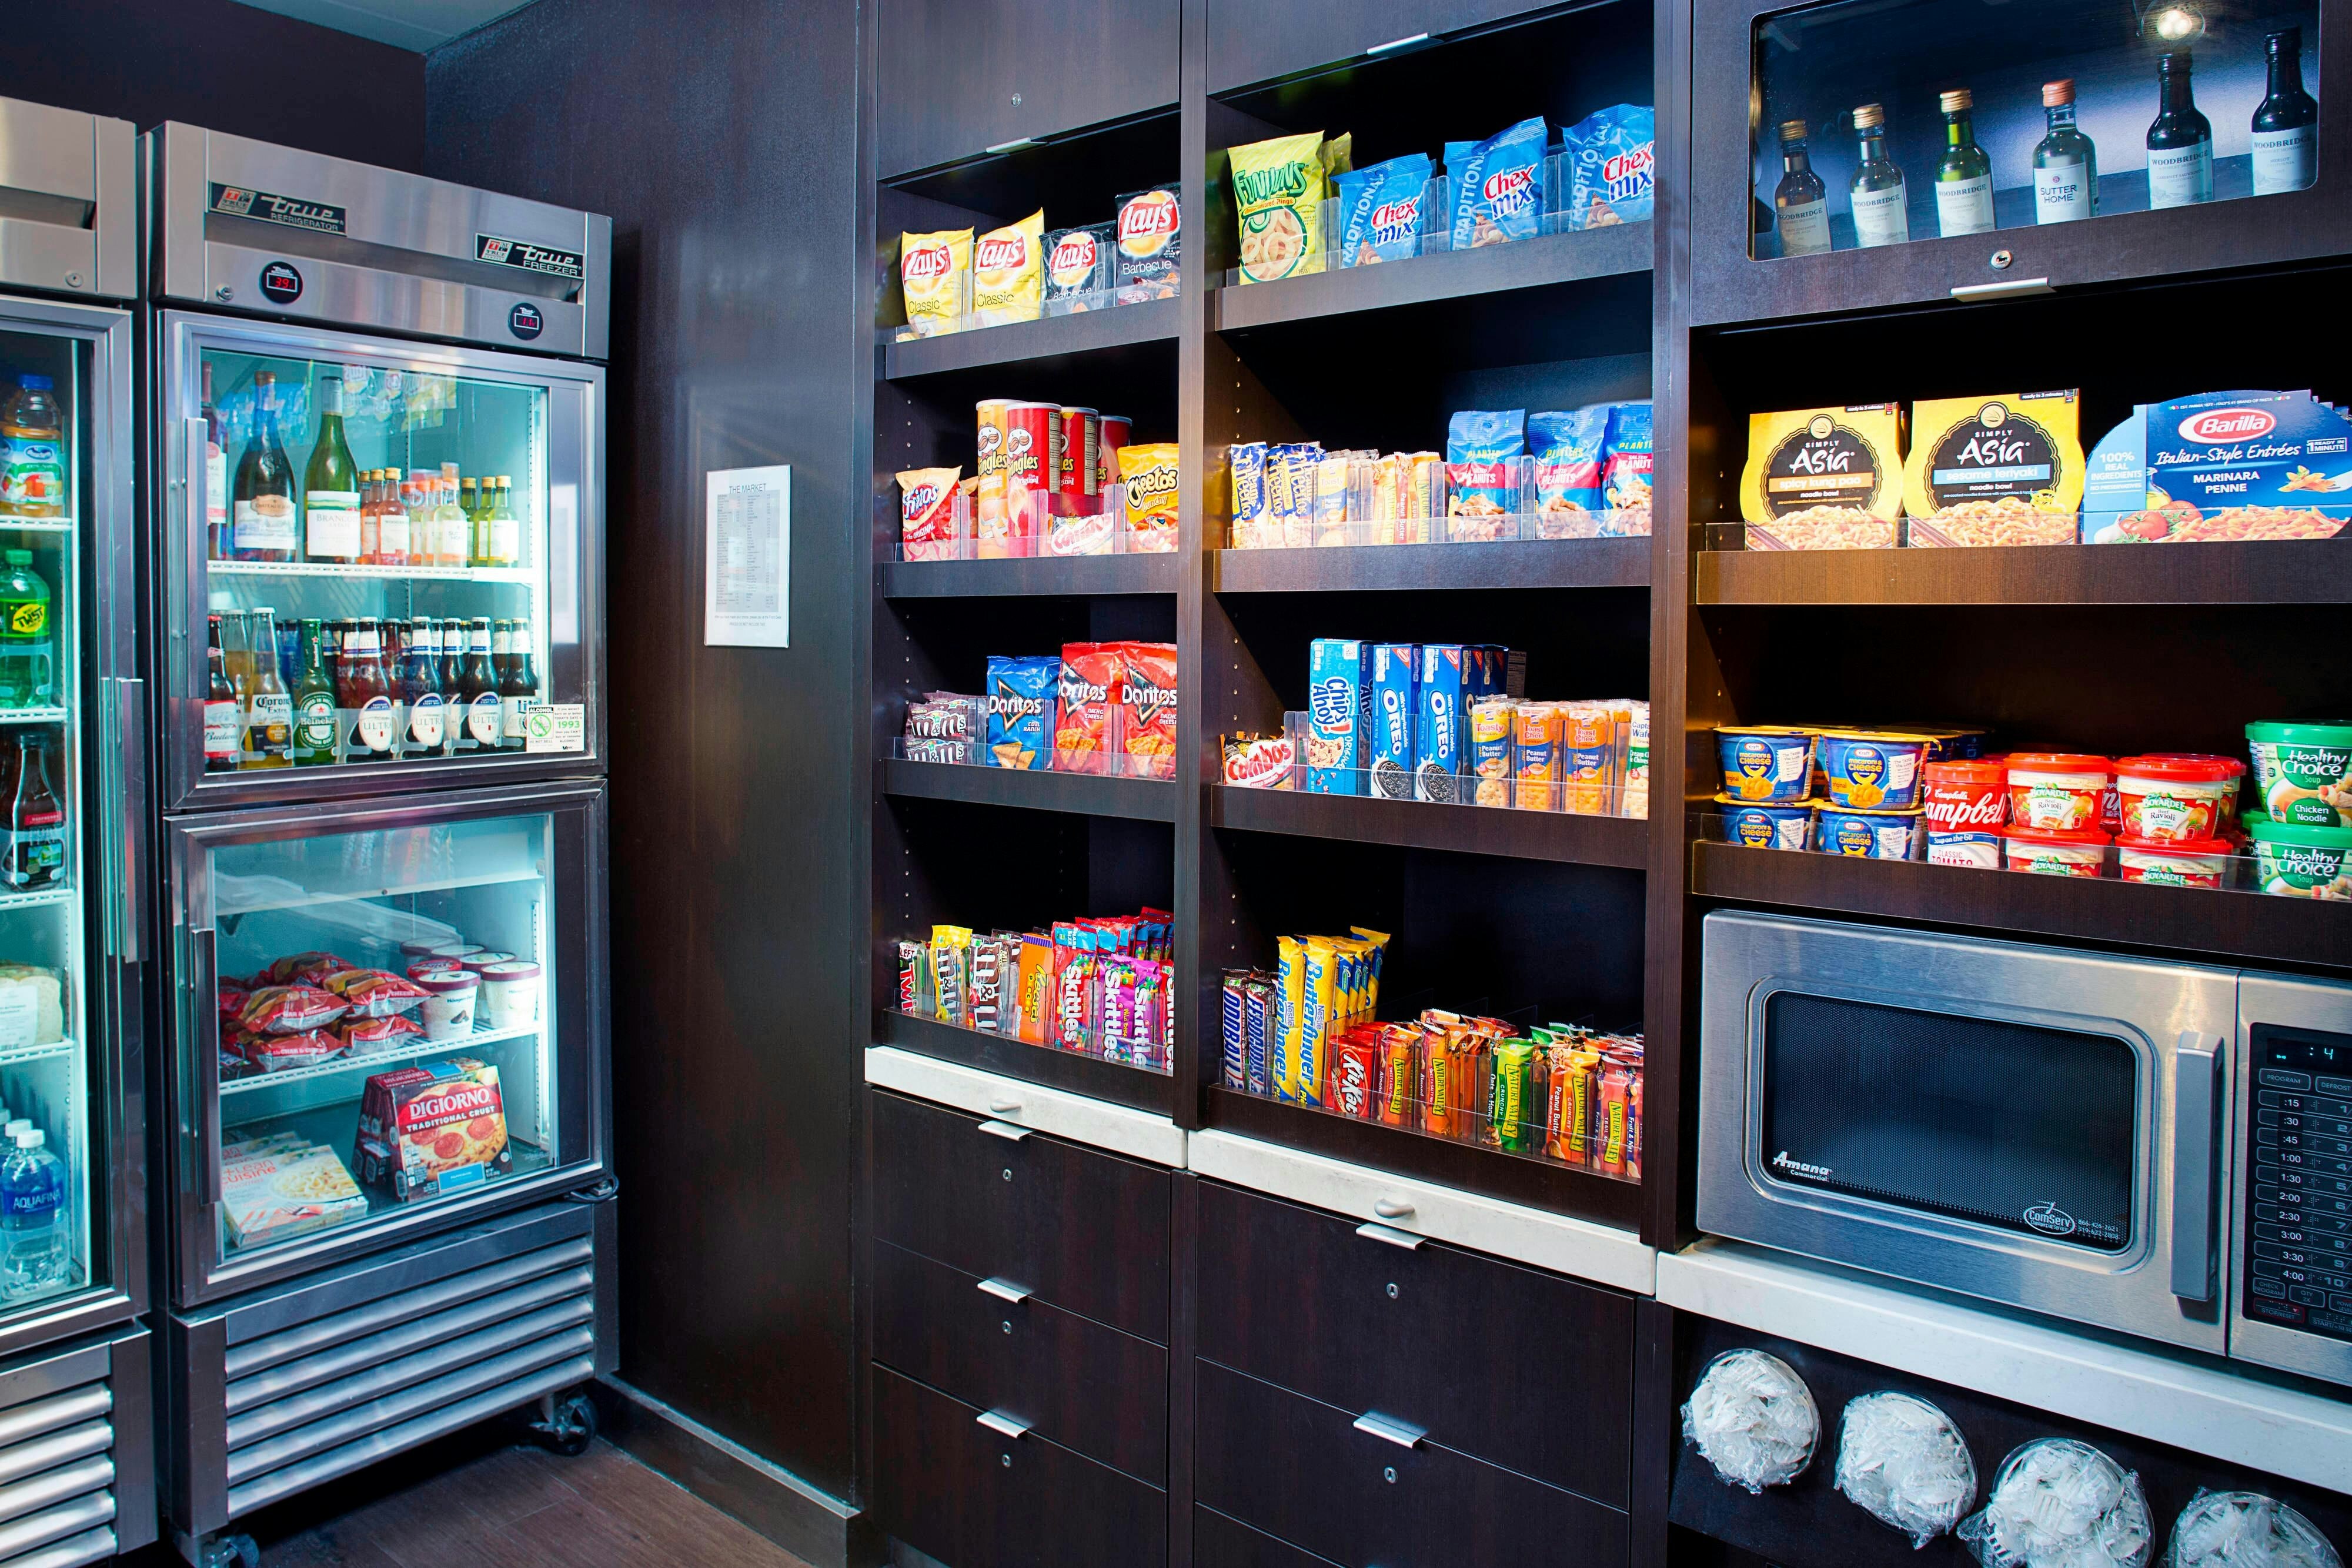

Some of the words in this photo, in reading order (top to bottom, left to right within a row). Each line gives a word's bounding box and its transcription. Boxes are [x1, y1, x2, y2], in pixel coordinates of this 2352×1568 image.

[1603, 142, 1653, 180] Chex
[2152, 150, 2209, 166] WOODBRIDGE
[1234, 161, 1307, 206] FUNYUNS
[1485, 166, 1533, 199] Chex
[1938, 184, 1986, 197] WOODBRIDGE
[2040, 185, 2077, 195] SUTTER
[1853, 194, 1900, 207] WOODBRIDGE
[2044, 193, 2073, 203] HOME
[1372, 198, 1418, 227] Chex
[1779, 207, 1823, 220] WOODBRIDGE
[270, 212, 339, 231] REFRIGERATOR
[1120, 201, 1176, 239] Lay's
[976, 236, 1024, 272] Lay's
[1051, 239, 1094, 276] Lay's
[523, 259, 578, 276] FREEZER
[906, 243, 947, 279] Lay's
[1053, 286, 1092, 302] Barbecue
[908, 297, 940, 313] Classic
[1975, 429, 2013, 438] SIMPLY
[2200, 414, 2267, 440] Barilla
[2308, 441, 2314, 453] 1
[1789, 447, 1850, 474] Asia
[2099, 452, 2135, 463] 100%
[2154, 446, 2244, 466] Italian-Style
[2247, 442, 2301, 459] Entrées
[1541, 472, 1576, 485] PEANUTS
[1946, 470, 1992, 482] sesame
[1994, 467, 2037, 480] teriyaki
[2090, 470, 2143, 481] INGREDIENTS
[2192, 471, 2260, 484] MARINARA
[729, 485, 741, 494] THE
[741, 483, 767, 493] MARKET
[1126, 465, 1178, 508] Cheetos
[1233, 458, 1252, 519] Cheerios
[1779, 479, 1807, 490] spicy
[1809, 477, 1836, 488] kung
[1839, 476, 1861, 487] pao
[2100, 482, 2142, 490] PRESERVATIVES
[2205, 484, 2247, 494] PENNE
[1142, 496, 1168, 512] Crunchy
[913, 521, 936, 539] ORIGINAL
[989, 696, 1041, 714] Doritos
[1326, 678, 1348, 725] Chips
[558, 720, 580, 728] 1993
[1382, 688, 1402, 756] OREO
[1476, 723, 1504, 733] Toasty
[1524, 724, 1544, 733] Toast
[1524, 731, 1545, 740] Chee
[1575, 727, 1596, 736] Toast
[2287, 749, 2347, 765] Healthy
[2281, 760, 2343, 776] Choice
[2305, 776, 2321, 784] Soup
[2030, 788, 2071, 801] BOYARDEE
[2037, 802, 2062, 810] Ravioli
[2294, 804, 2330, 814] Chicken
[2150, 812, 2176, 821] Ravioli
[2297, 814, 2327, 823] Noodle
[1938, 850, 1963, 859] CLASSIC
[900, 949, 915, 958] LEFT
[1064, 965, 1083, 1042] Skittles
[1274, 957, 1291, 1082] Butterfinger
[1396, 1060, 1404, 1088] NATURE
[1435, 1061, 1444, 1089] NATURE
[2267, 1074, 2301, 1084] PROGRAM
[2321, 1082, 2351, 1091] DEFROST
[409, 1089, 489, 1119] DIGIORNO
[1395, 1089, 1403, 1114] VALLEY
[1435, 1089, 1444, 1115] VALLEY
[1553, 1085, 1562, 1112] Peanut
[2284, 1098, 2300, 1107] :15
[406, 1114, 467, 1132] TRADITIONAL
[470, 1105, 495, 1118] CRUST
[1551, 1112, 1561, 1137] Butter
[2283, 1117, 2298, 1126] :30
[2283, 1135, 2298, 1144] :45
[1772, 1151, 1829, 1176] Amana
[2281, 1153, 2301, 1164] 1:00
[1790, 1169, 1828, 1182] Commercial
[2281, 1174, 2301, 1184] 1:30
[13, 1188, 62, 1210] AQUAFINA
[2279, 1192, 2300, 1203] 2:00
[2029, 1209, 2072, 1228] ComServ
[2278, 1211, 2300, 1222] 2:30
[2077, 1219, 2119, 1232] 866-426-2621
[2281, 1231, 2302, 1241] 3:00
[2283, 1251, 2304, 1263] 3:30
[2283, 1270, 2304, 1282] 4:00
[2254, 1286, 2283, 1297] PROGRAM
[2259, 1281, 2278, 1290] CHECK
